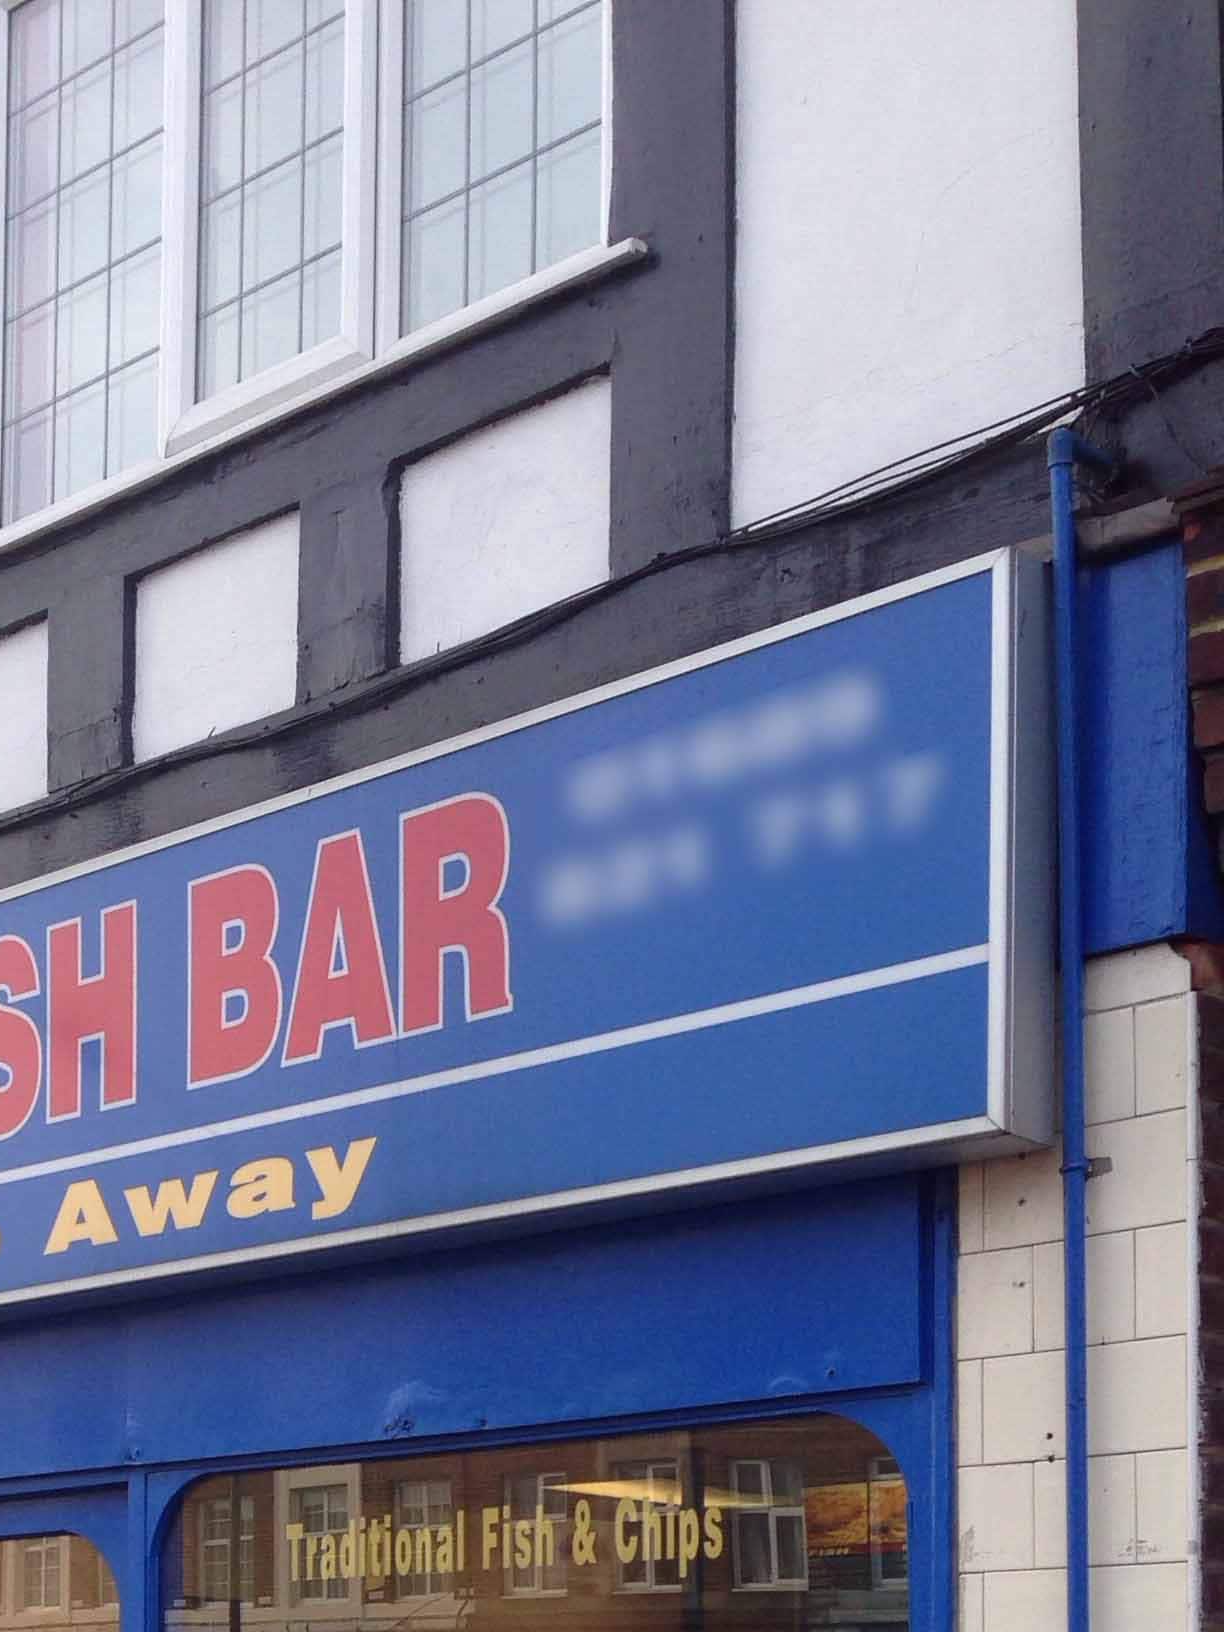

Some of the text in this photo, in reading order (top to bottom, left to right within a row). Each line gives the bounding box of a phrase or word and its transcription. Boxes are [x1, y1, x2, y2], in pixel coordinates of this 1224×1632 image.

[187, 792, 513, 1091] BAR
[44, 1137, 377, 1255] Away
[286, 1494, 724, 1582] Traditional Fish & Chips
